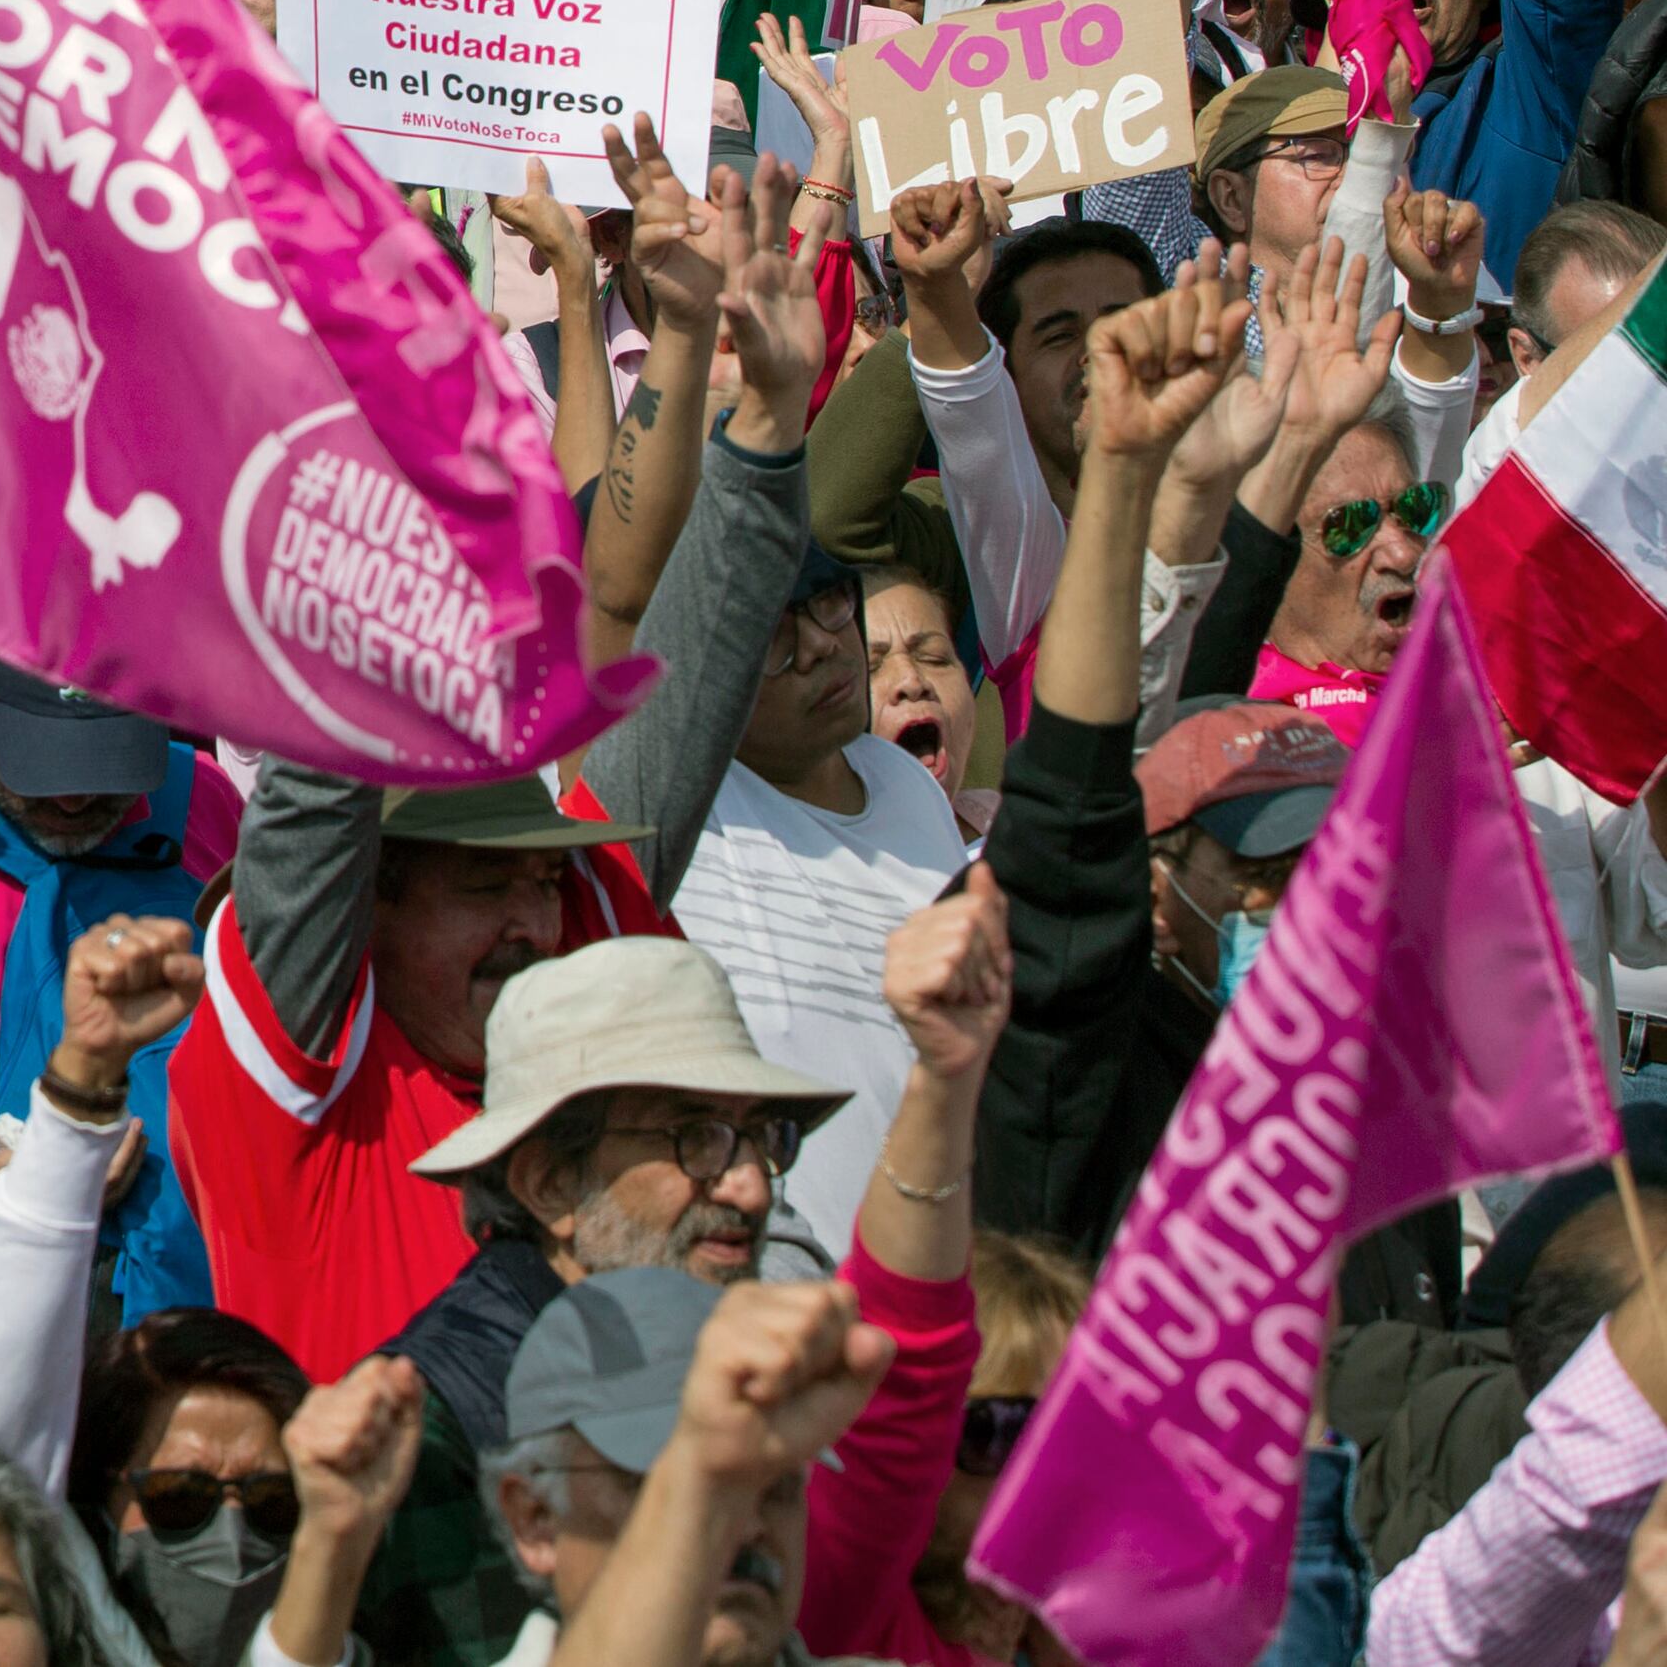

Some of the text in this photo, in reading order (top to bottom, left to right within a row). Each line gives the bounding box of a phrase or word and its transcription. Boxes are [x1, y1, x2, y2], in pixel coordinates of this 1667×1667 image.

[385, 22, 582, 67] Ciudadana
[349, 66, 624, 116] en el Congreso
[402, 111, 562, 144] #MiVotoNoSeToca
[857, 72, 1169, 214] Libre
[288, 447, 463, 584] #NUES
[262, 565, 504, 757] NOSETOCA
[1309, 687, 1368, 708] Marcha
